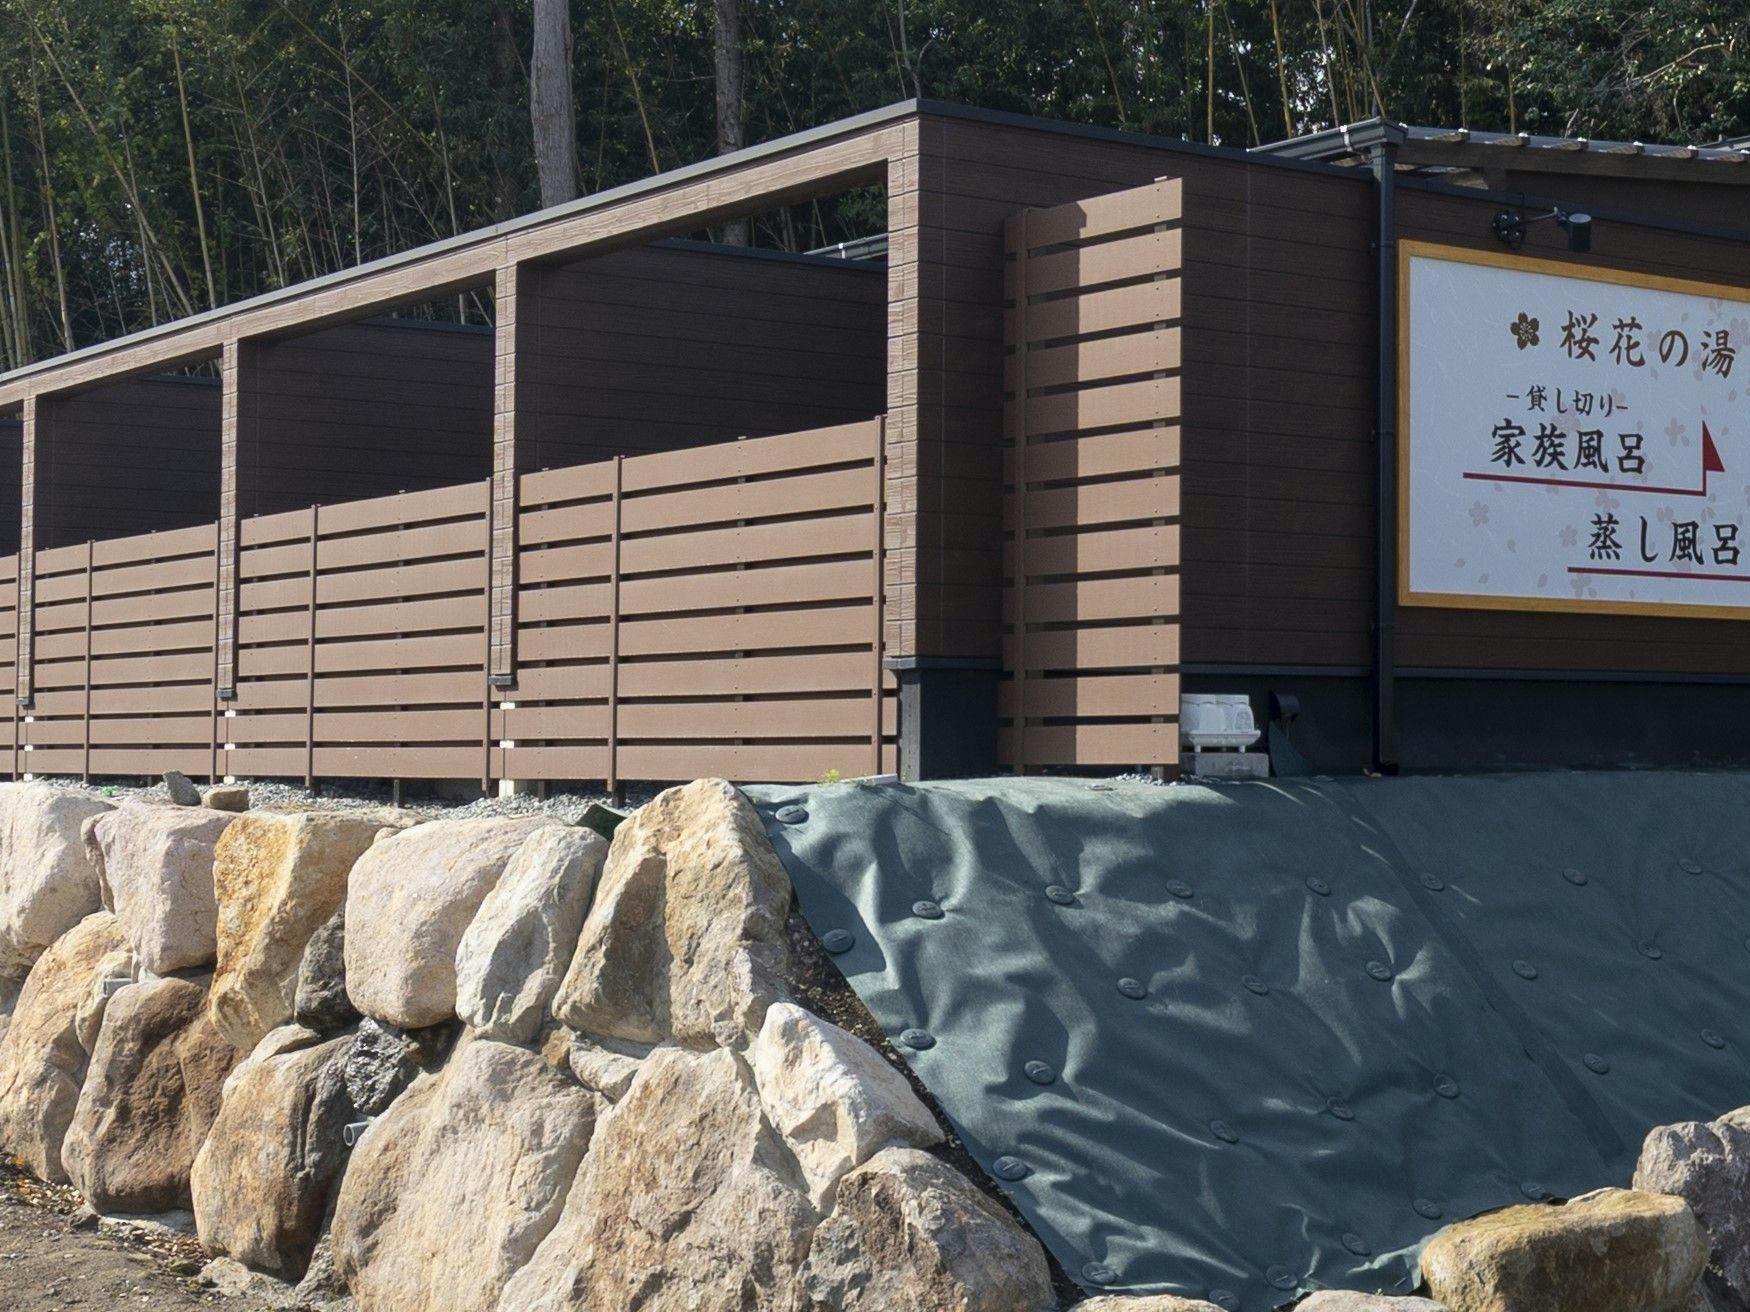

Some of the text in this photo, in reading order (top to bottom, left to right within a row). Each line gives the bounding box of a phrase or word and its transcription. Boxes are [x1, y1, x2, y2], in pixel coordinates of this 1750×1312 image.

[1560, 310, 1737, 379] 桜花の湯
[1490, 418, 1646, 475] 家族風呂
[1588, 512, 1740, 566] 蒸し風呂
